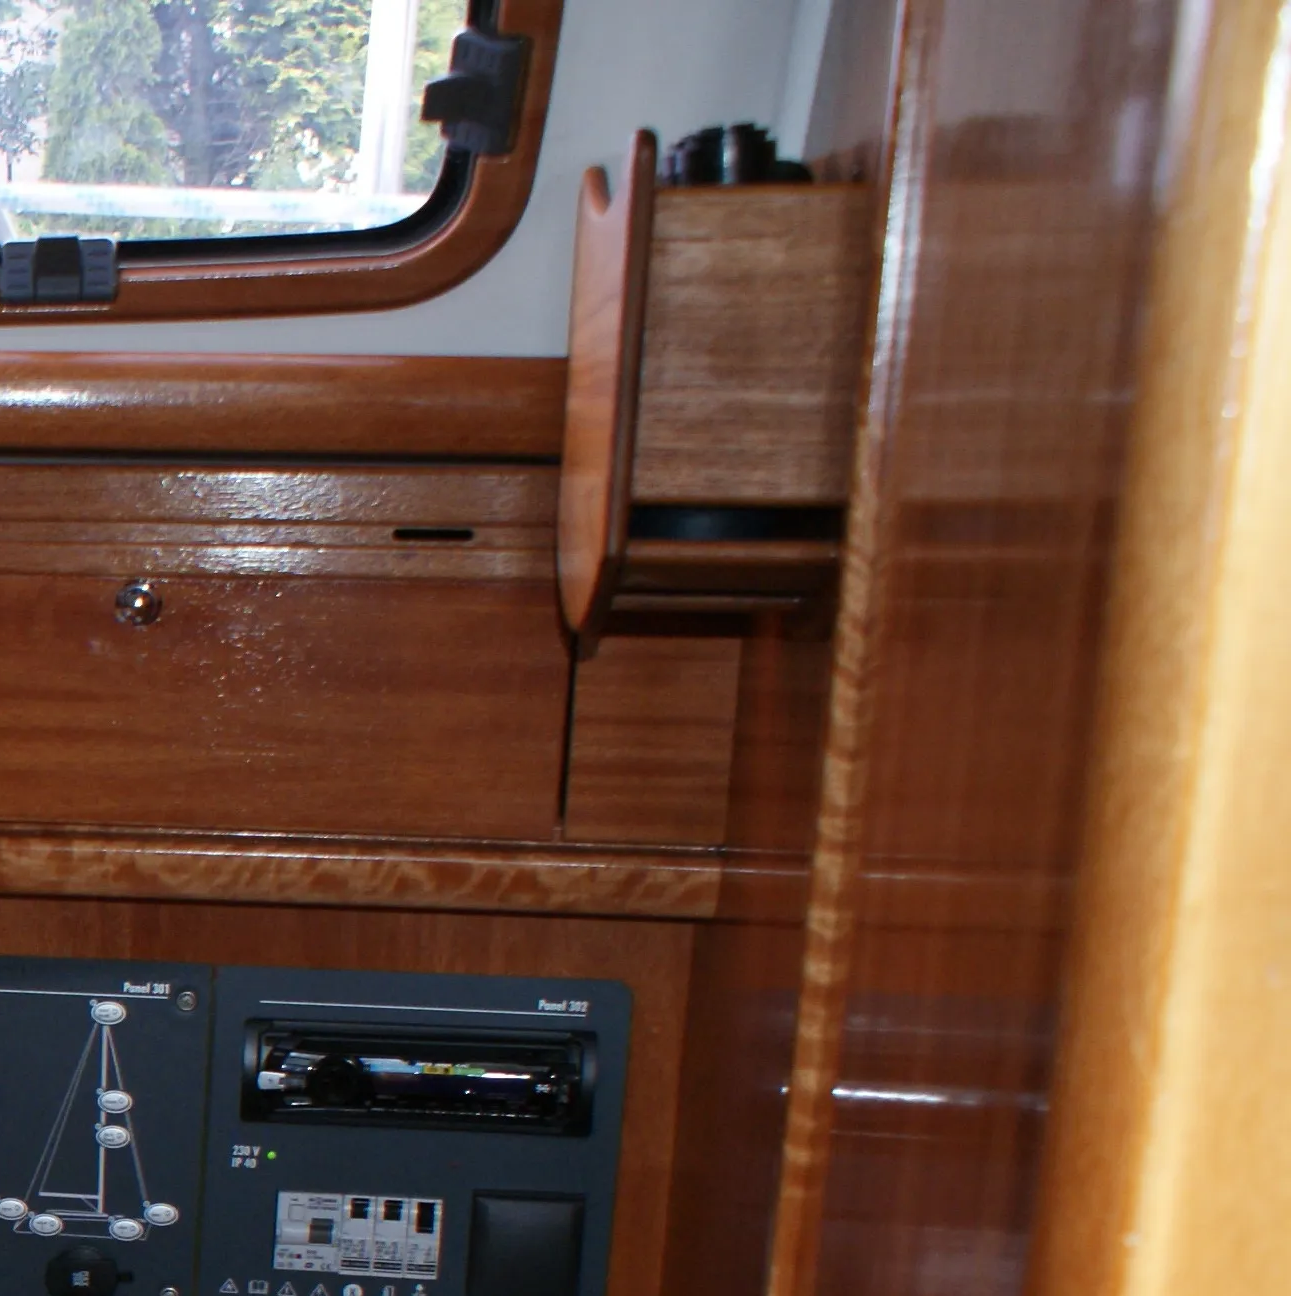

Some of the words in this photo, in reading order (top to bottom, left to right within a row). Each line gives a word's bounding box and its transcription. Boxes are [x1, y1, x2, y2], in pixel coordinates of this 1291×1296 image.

[123, 981, 151, 994] Panel
[152, 982, 171, 995] 301
[537, 999, 567, 1012] Panel
